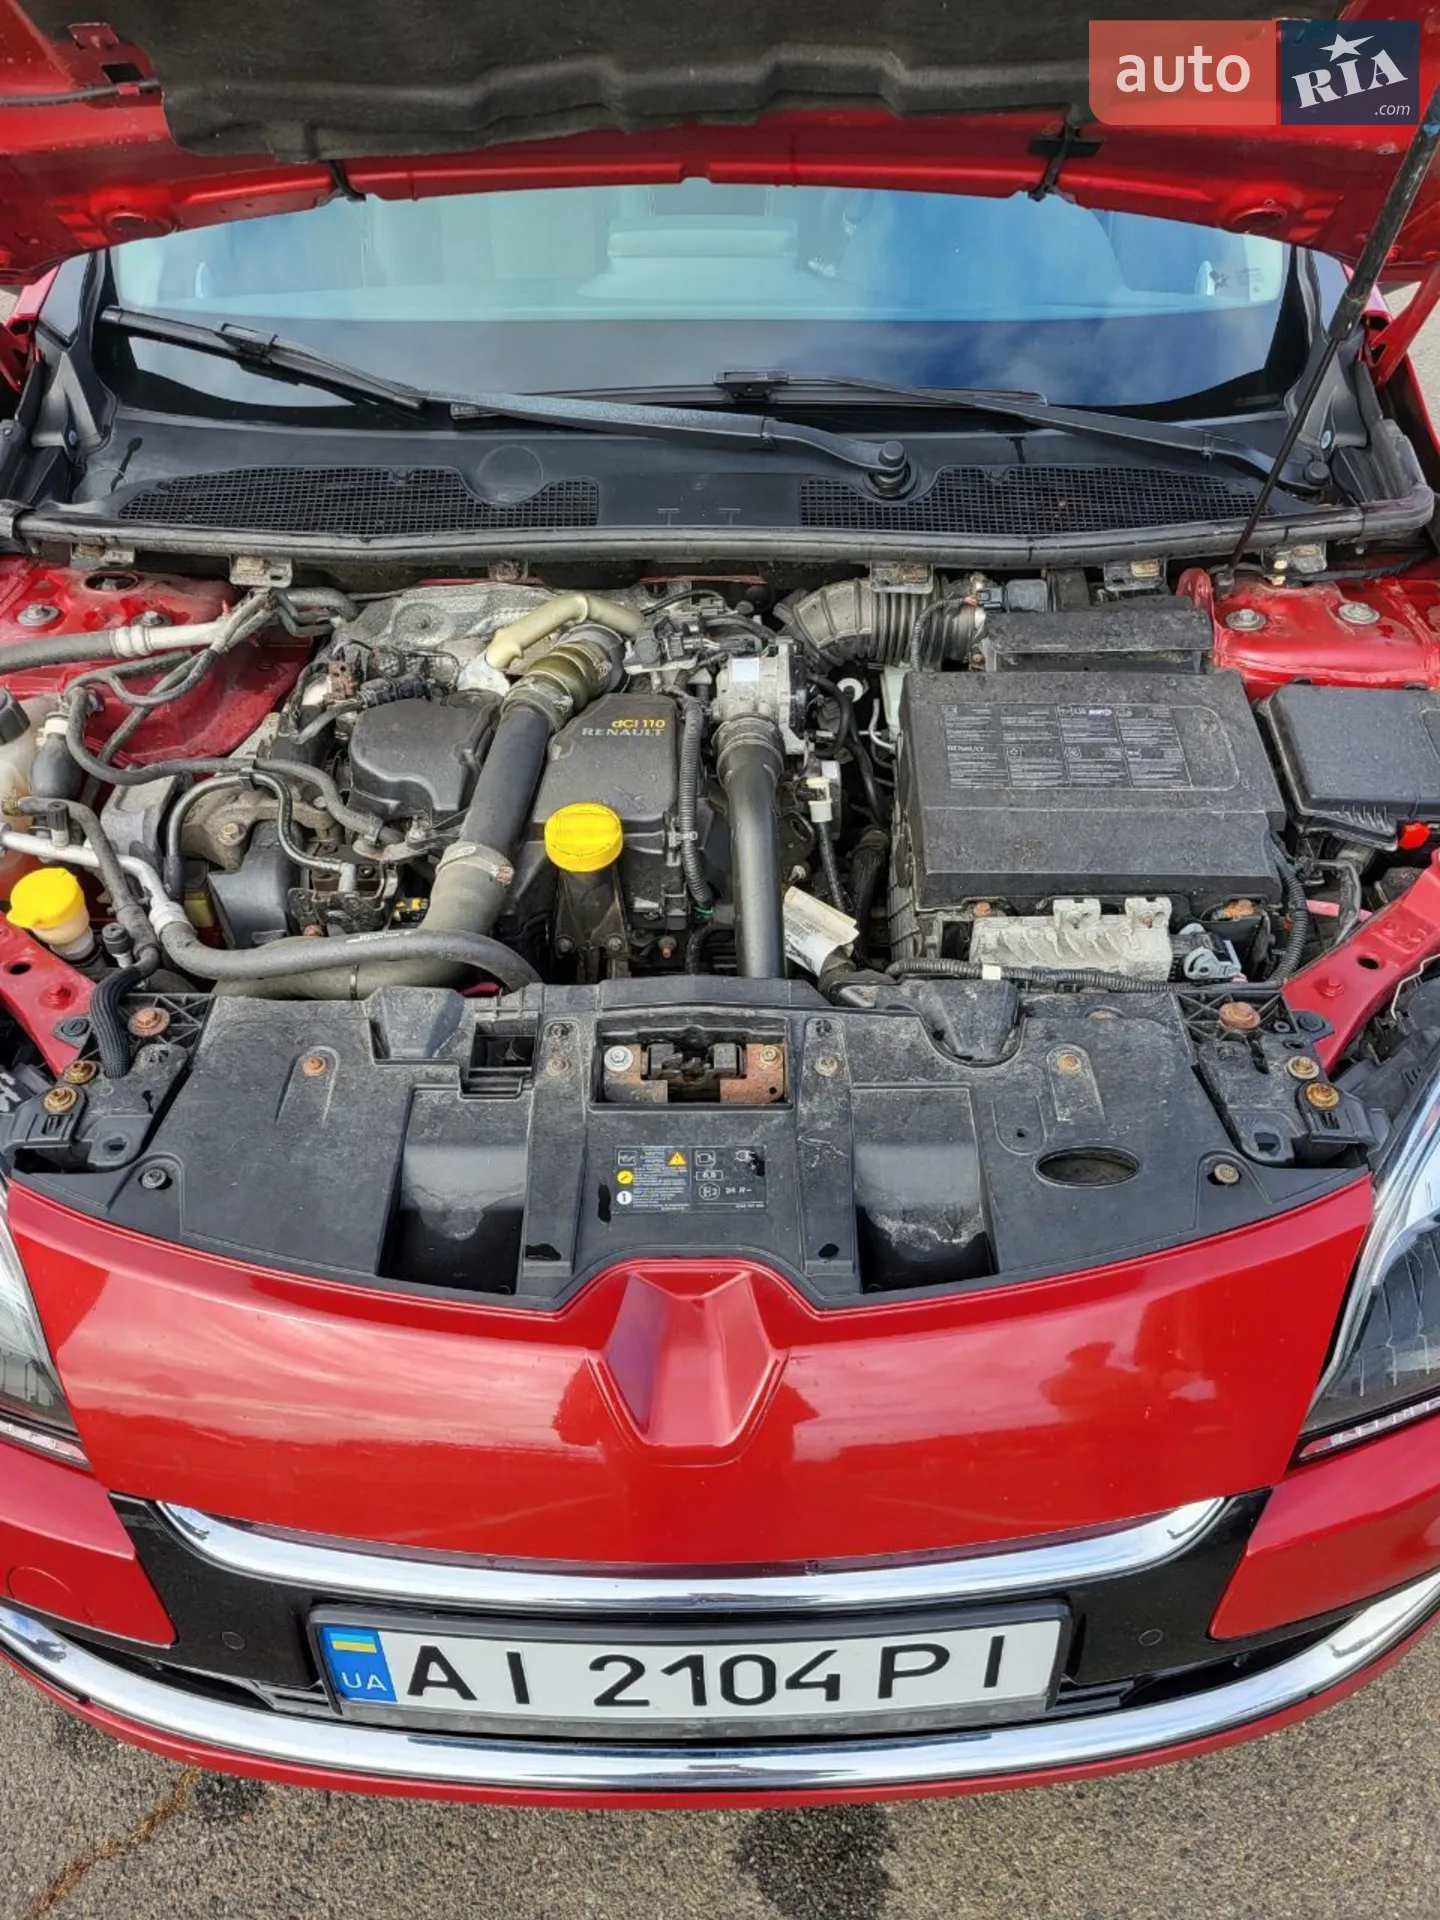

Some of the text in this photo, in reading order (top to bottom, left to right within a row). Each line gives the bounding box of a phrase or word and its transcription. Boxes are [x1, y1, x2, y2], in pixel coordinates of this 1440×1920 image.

[642, 719, 666, 728] 110
[582, 727, 664, 736] RENAULT
[407, 1634, 1005, 1707] AI 2104 PI
[341, 1671, 387, 1692] UA
